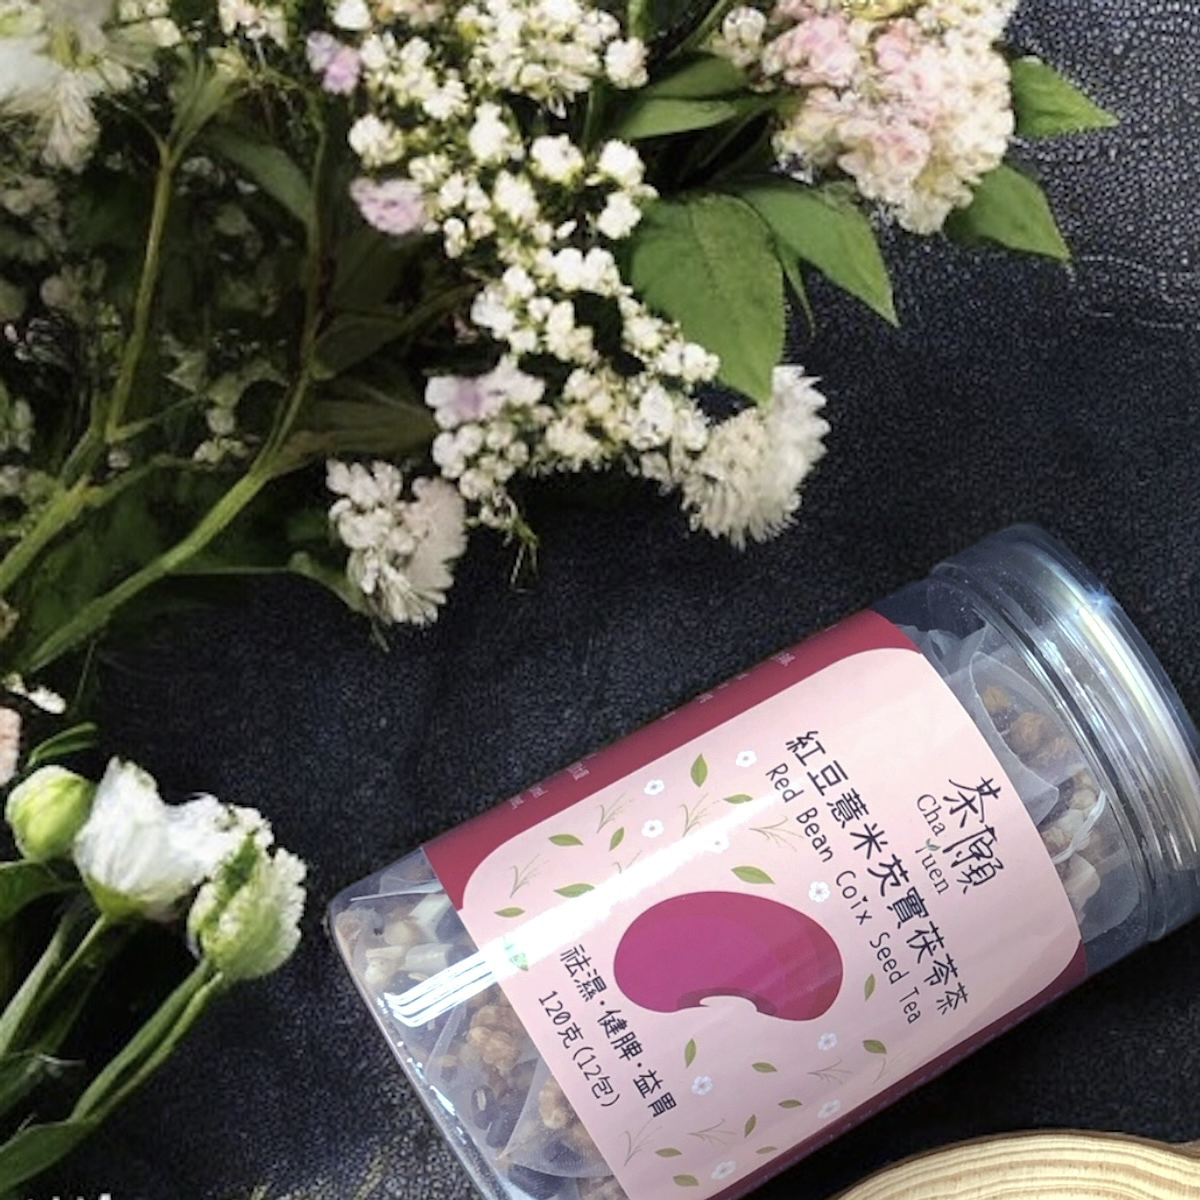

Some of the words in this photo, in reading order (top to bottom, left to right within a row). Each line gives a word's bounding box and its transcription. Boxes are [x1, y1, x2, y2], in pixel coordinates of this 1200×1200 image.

[784, 730, 969, 1016] 紅豆薏米芡實茯苓茶
[914, 837, 950, 896] Yuen
[916, 793, 946, 837] Cha
[942, 775, 1004, 895] 茶願
[765, 762, 803, 804] Red
[796, 807, 834, 863] Bean
[835, 869, 872, 925] Coix
[869, 931, 909, 986] Seed
[898, 986, 922, 1024] Tea
